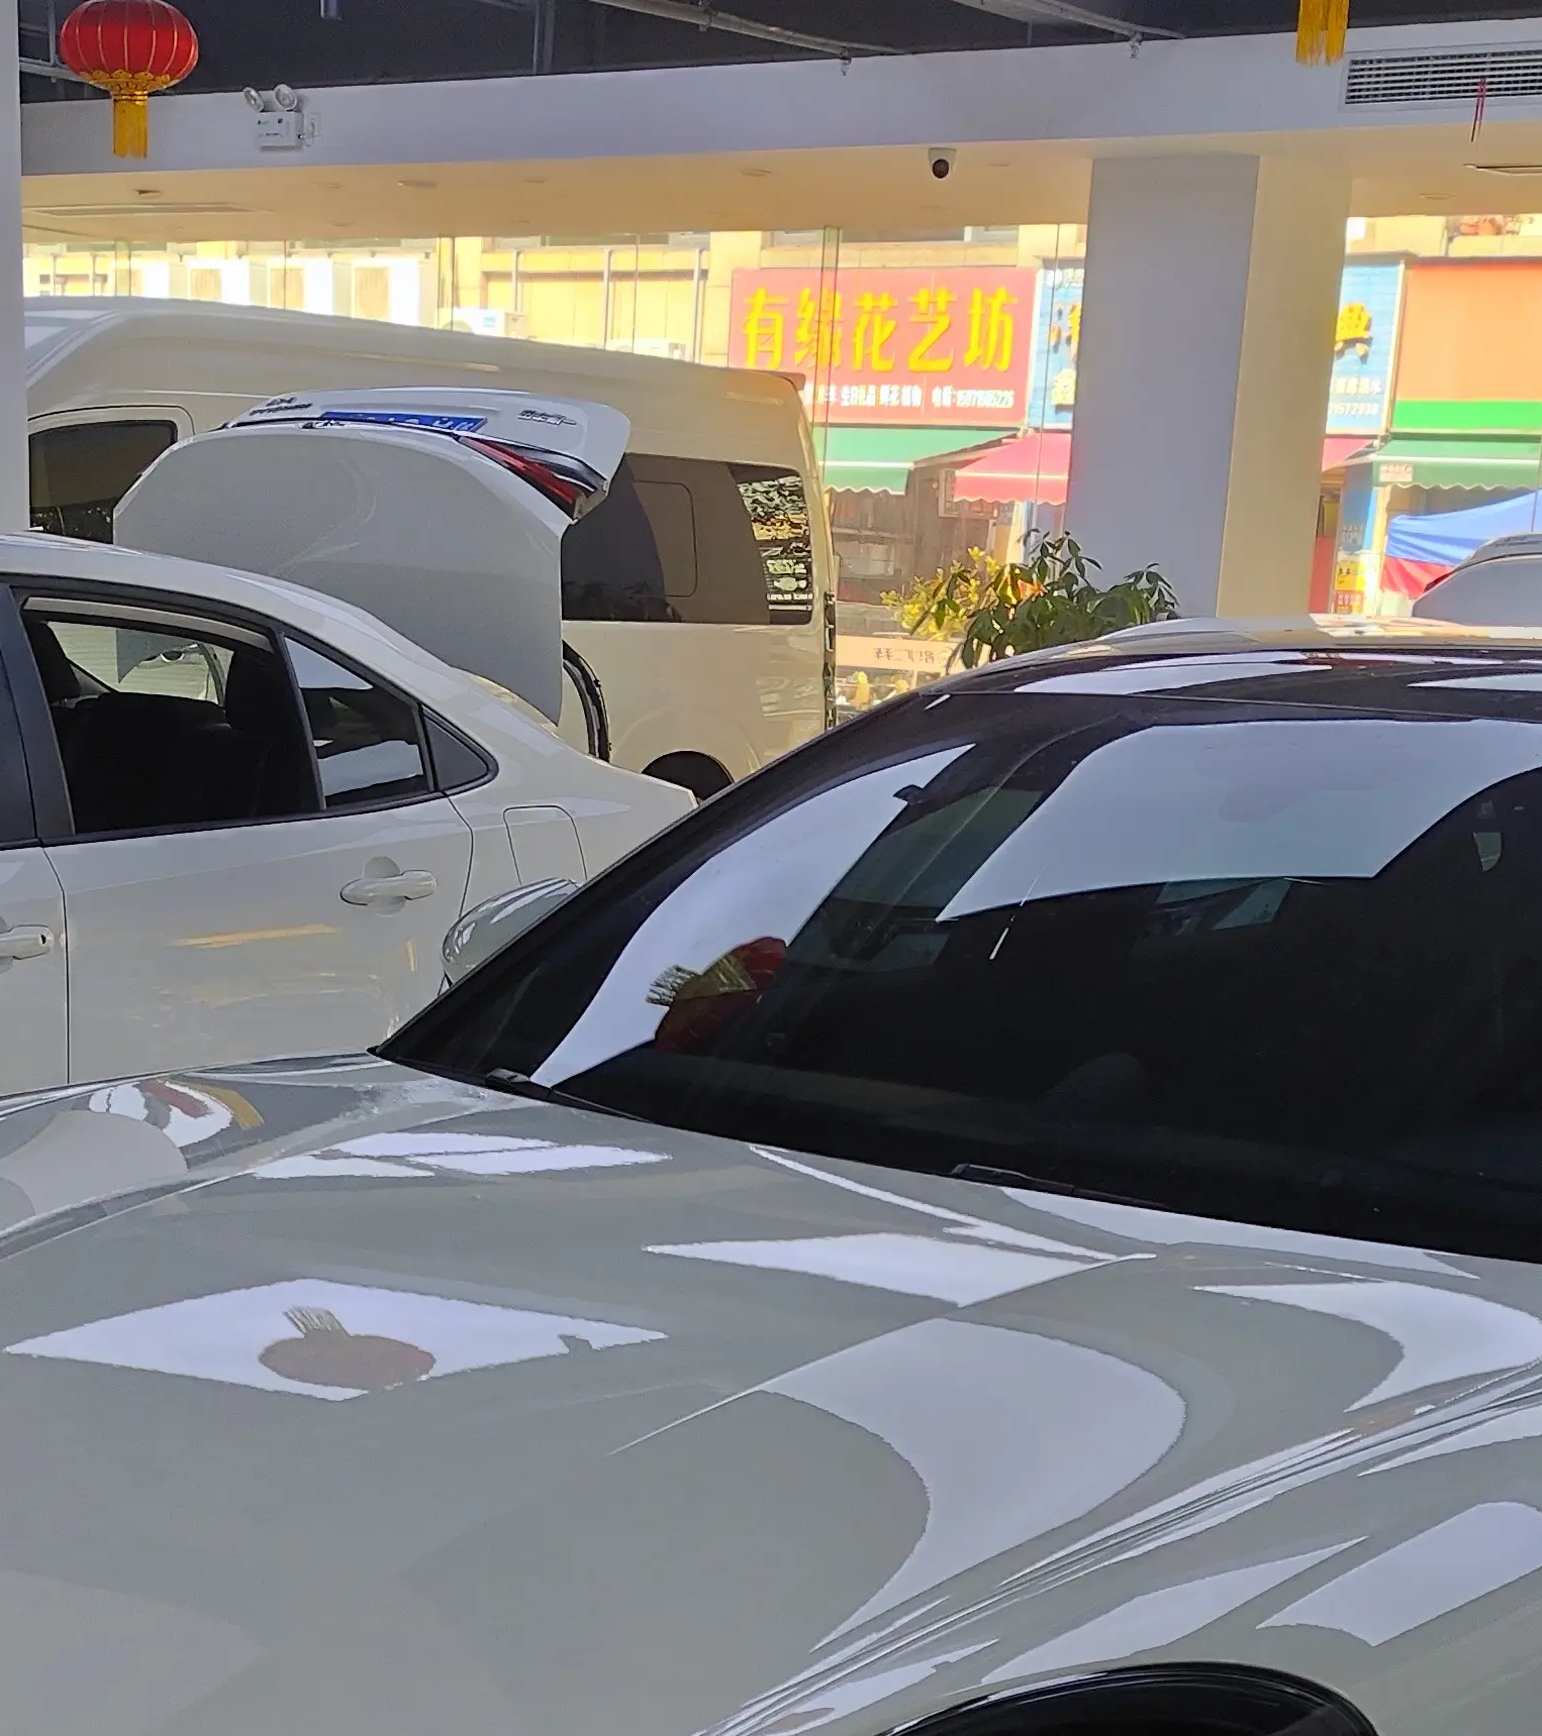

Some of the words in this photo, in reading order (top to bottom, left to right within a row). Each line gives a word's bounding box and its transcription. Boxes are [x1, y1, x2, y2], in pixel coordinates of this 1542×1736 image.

[742, 286, 1019, 373] 有缘花艺坊
